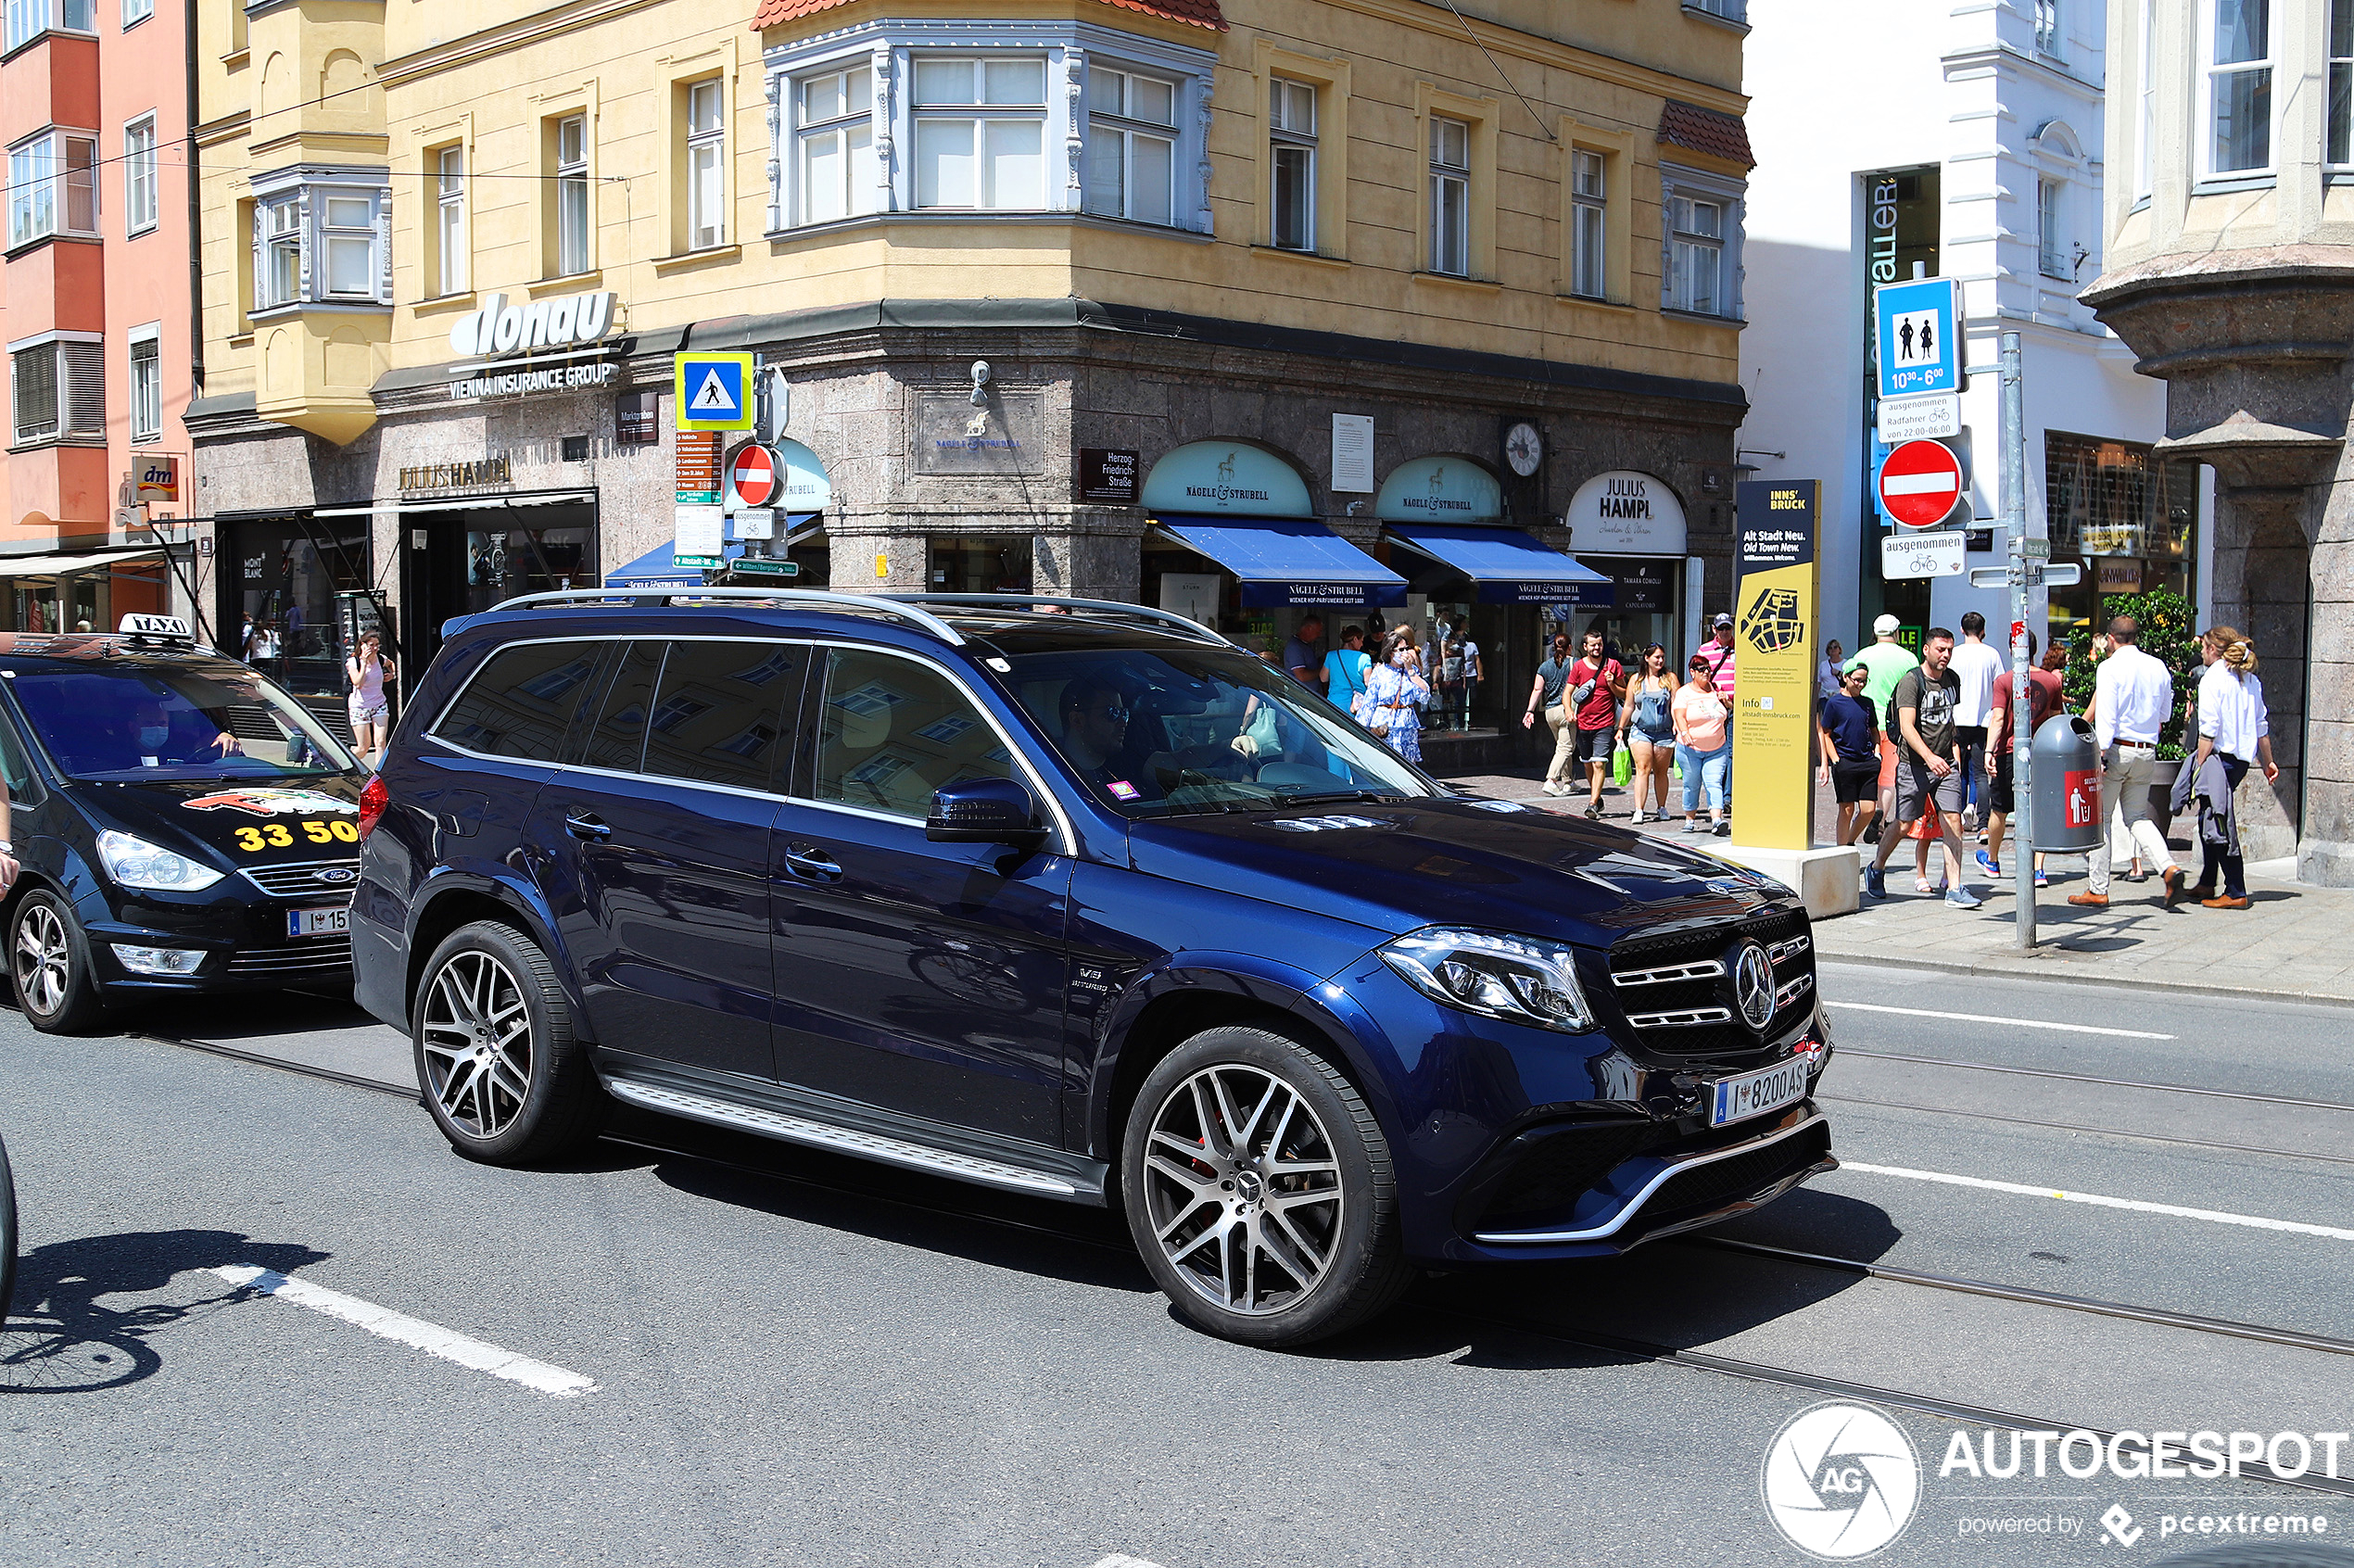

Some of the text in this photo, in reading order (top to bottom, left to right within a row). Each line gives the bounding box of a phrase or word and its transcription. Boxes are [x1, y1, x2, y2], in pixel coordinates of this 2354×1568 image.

[450, 292, 615, 355] donau
[449, 362, 612, 400] VIENNA INSURANCE GROUP
[1889, 398, 1947, 411] ausgenommen
[1887, 416, 1926, 425] Radfahrer
[1905, 424, 1951, 436] 22:00-06:00
[1108, 452, 1134, 465] Herzog-
[144, 465, 172, 484] dm
[1103, 464, 1134, 474] Friedrich-
[397, 464, 449, 490] JULIUS
[1108, 476, 1133, 487] Straße
[1186, 485, 1269, 500] NÄGELE & STRUBELL
[1607, 478, 1646, 497] JULIUS
[1429, 496, 1438, 511] &
[1439, 499, 1472, 511] STRUBELL
[1770, 499, 1806, 510] BRUCK
[735, 512, 771, 521] ausgenommen
[1743, 529, 1806, 541] Alt Stadt Neu.
[1743, 541, 1800, 552] Old Town New.
[1886, 537, 1960, 553] ausgenommen
[245, 558, 261, 569] MONT
[245, 568, 262, 578] BLANC
[1319, 584, 1327, 595] &
[1327, 586, 1364, 595] STRUBELL
[1550, 585, 1579, 593] STRUBELL
[134, 616, 185, 633] TAXI
[1742, 697, 1760, 708] Info
[1742, 711, 1800, 719] altstadt-innsbruck.com
[234, 820, 360, 852] 33 50
[329, 871, 347, 879] Ford
[1080, 967, 1102, 980] V8
[1071, 980, 1108, 992] BITURBO
[1718, 1108, 1724, 1118] A
